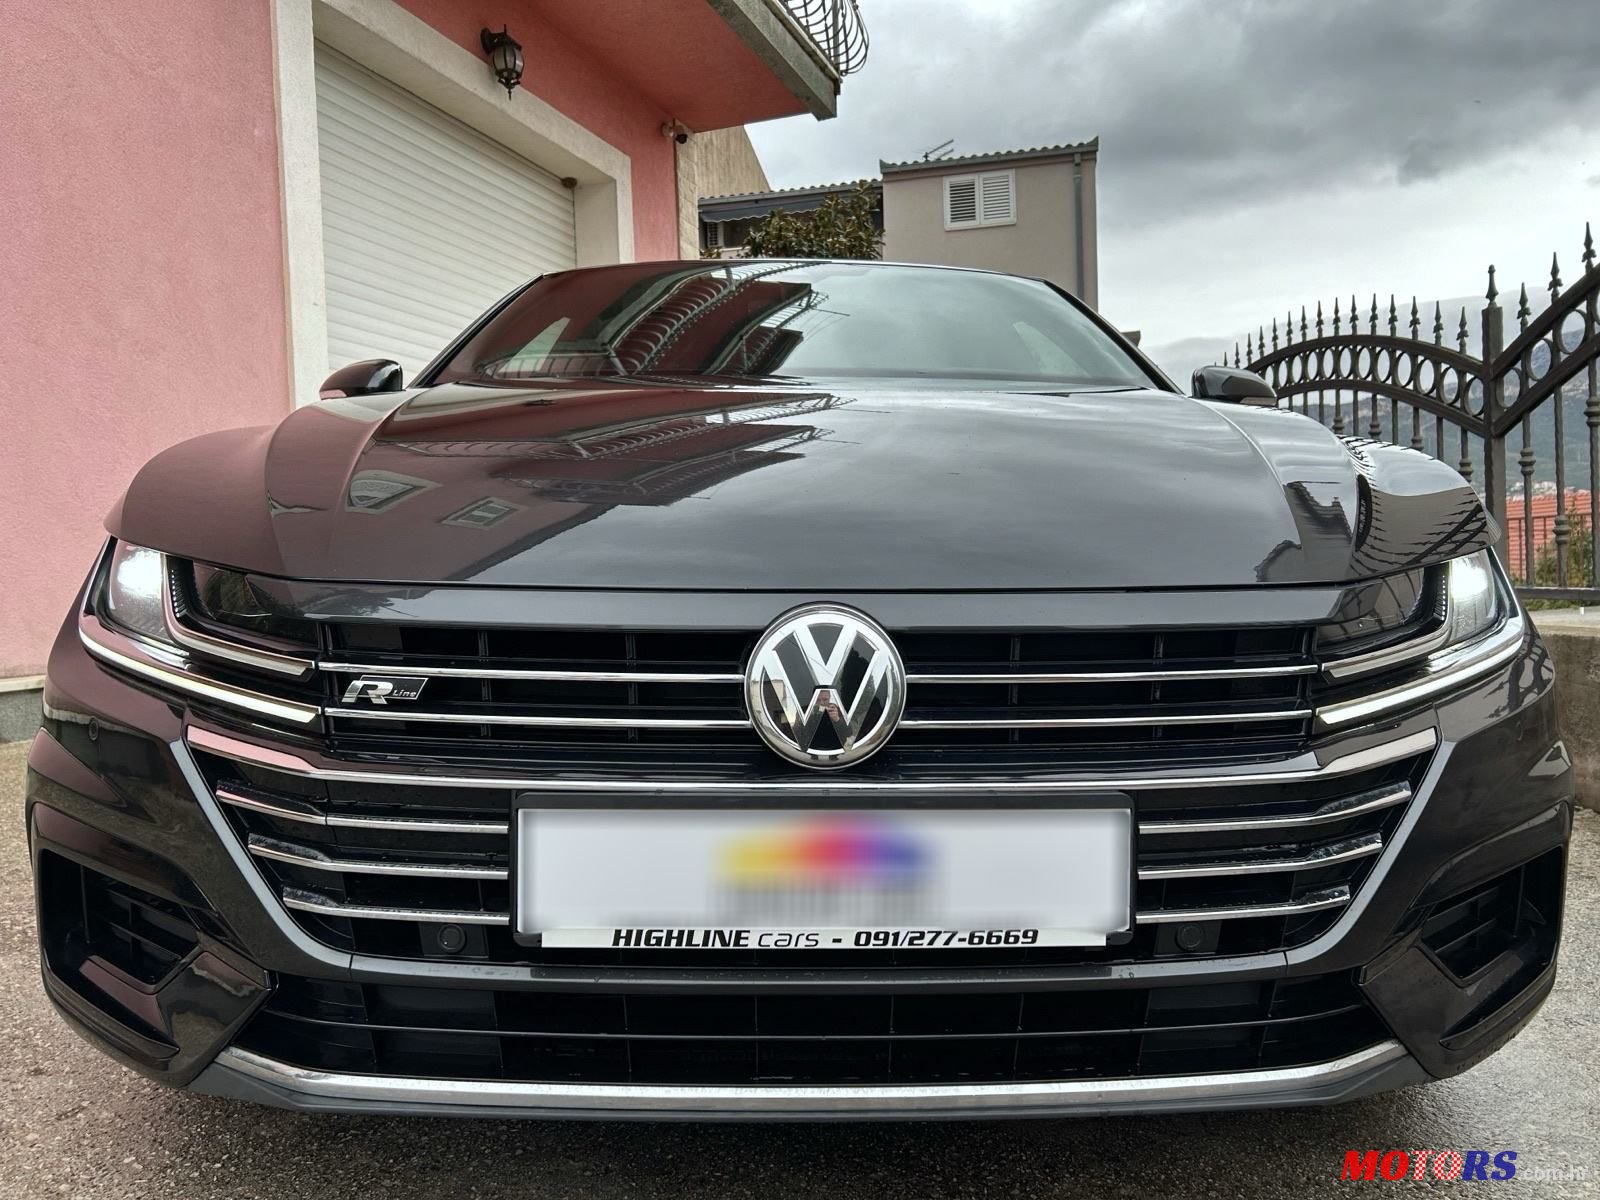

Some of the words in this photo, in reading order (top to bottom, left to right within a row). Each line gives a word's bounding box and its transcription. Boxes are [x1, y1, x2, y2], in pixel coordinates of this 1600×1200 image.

[341, 680, 394, 704] R
[392, 689, 417, 698] Line
[612, 929, 750, 948] HIGHLINE
[757, 932, 820, 948] cars
[854, 929, 1039, 947] 091/277-6669
